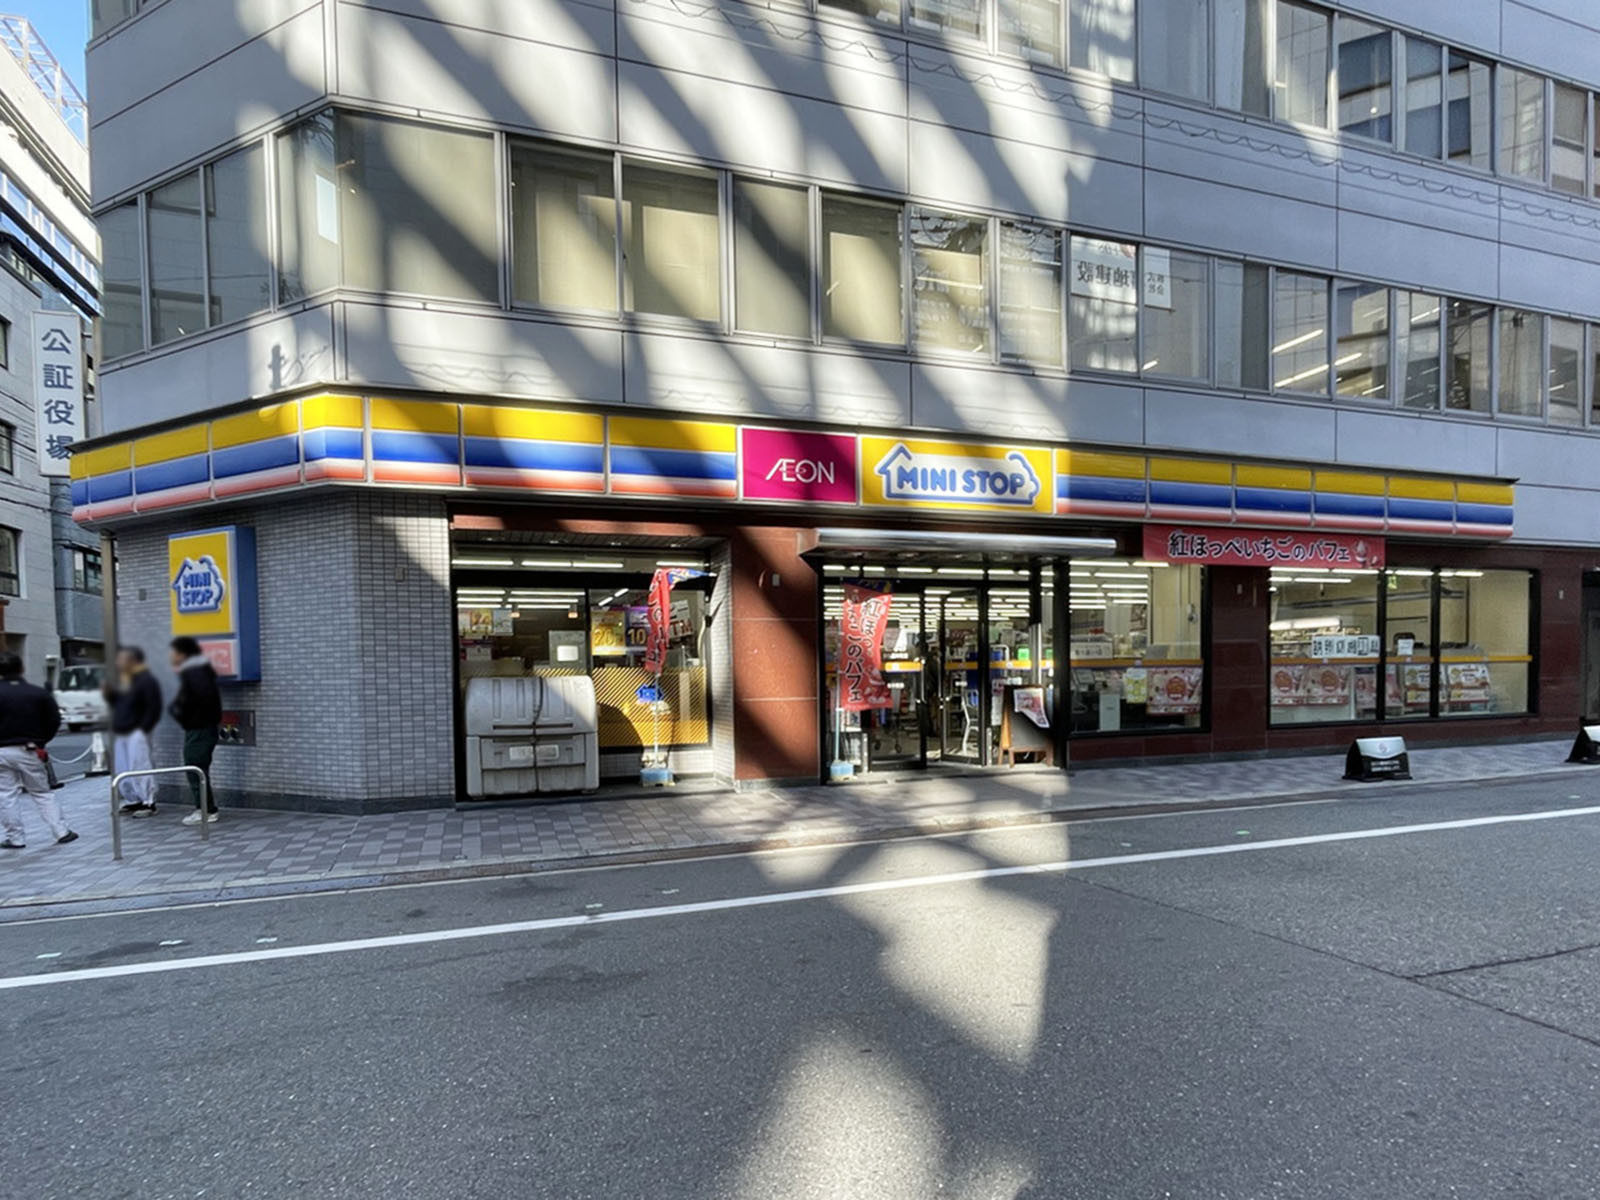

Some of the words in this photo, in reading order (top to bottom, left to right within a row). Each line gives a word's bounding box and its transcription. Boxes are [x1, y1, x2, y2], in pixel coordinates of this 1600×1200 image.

[41, 327, 75, 461] 公証役場
[896, 465, 956, 492] MINI
[962, 470, 1026, 496] STOP
[1167, 531, 1351, 563] 紅ほっぺいちごのパフェ
[182, 571, 212, 589] MINI
[182, 587, 214, 606] STOP
[669, 618, 694, 637] TM
